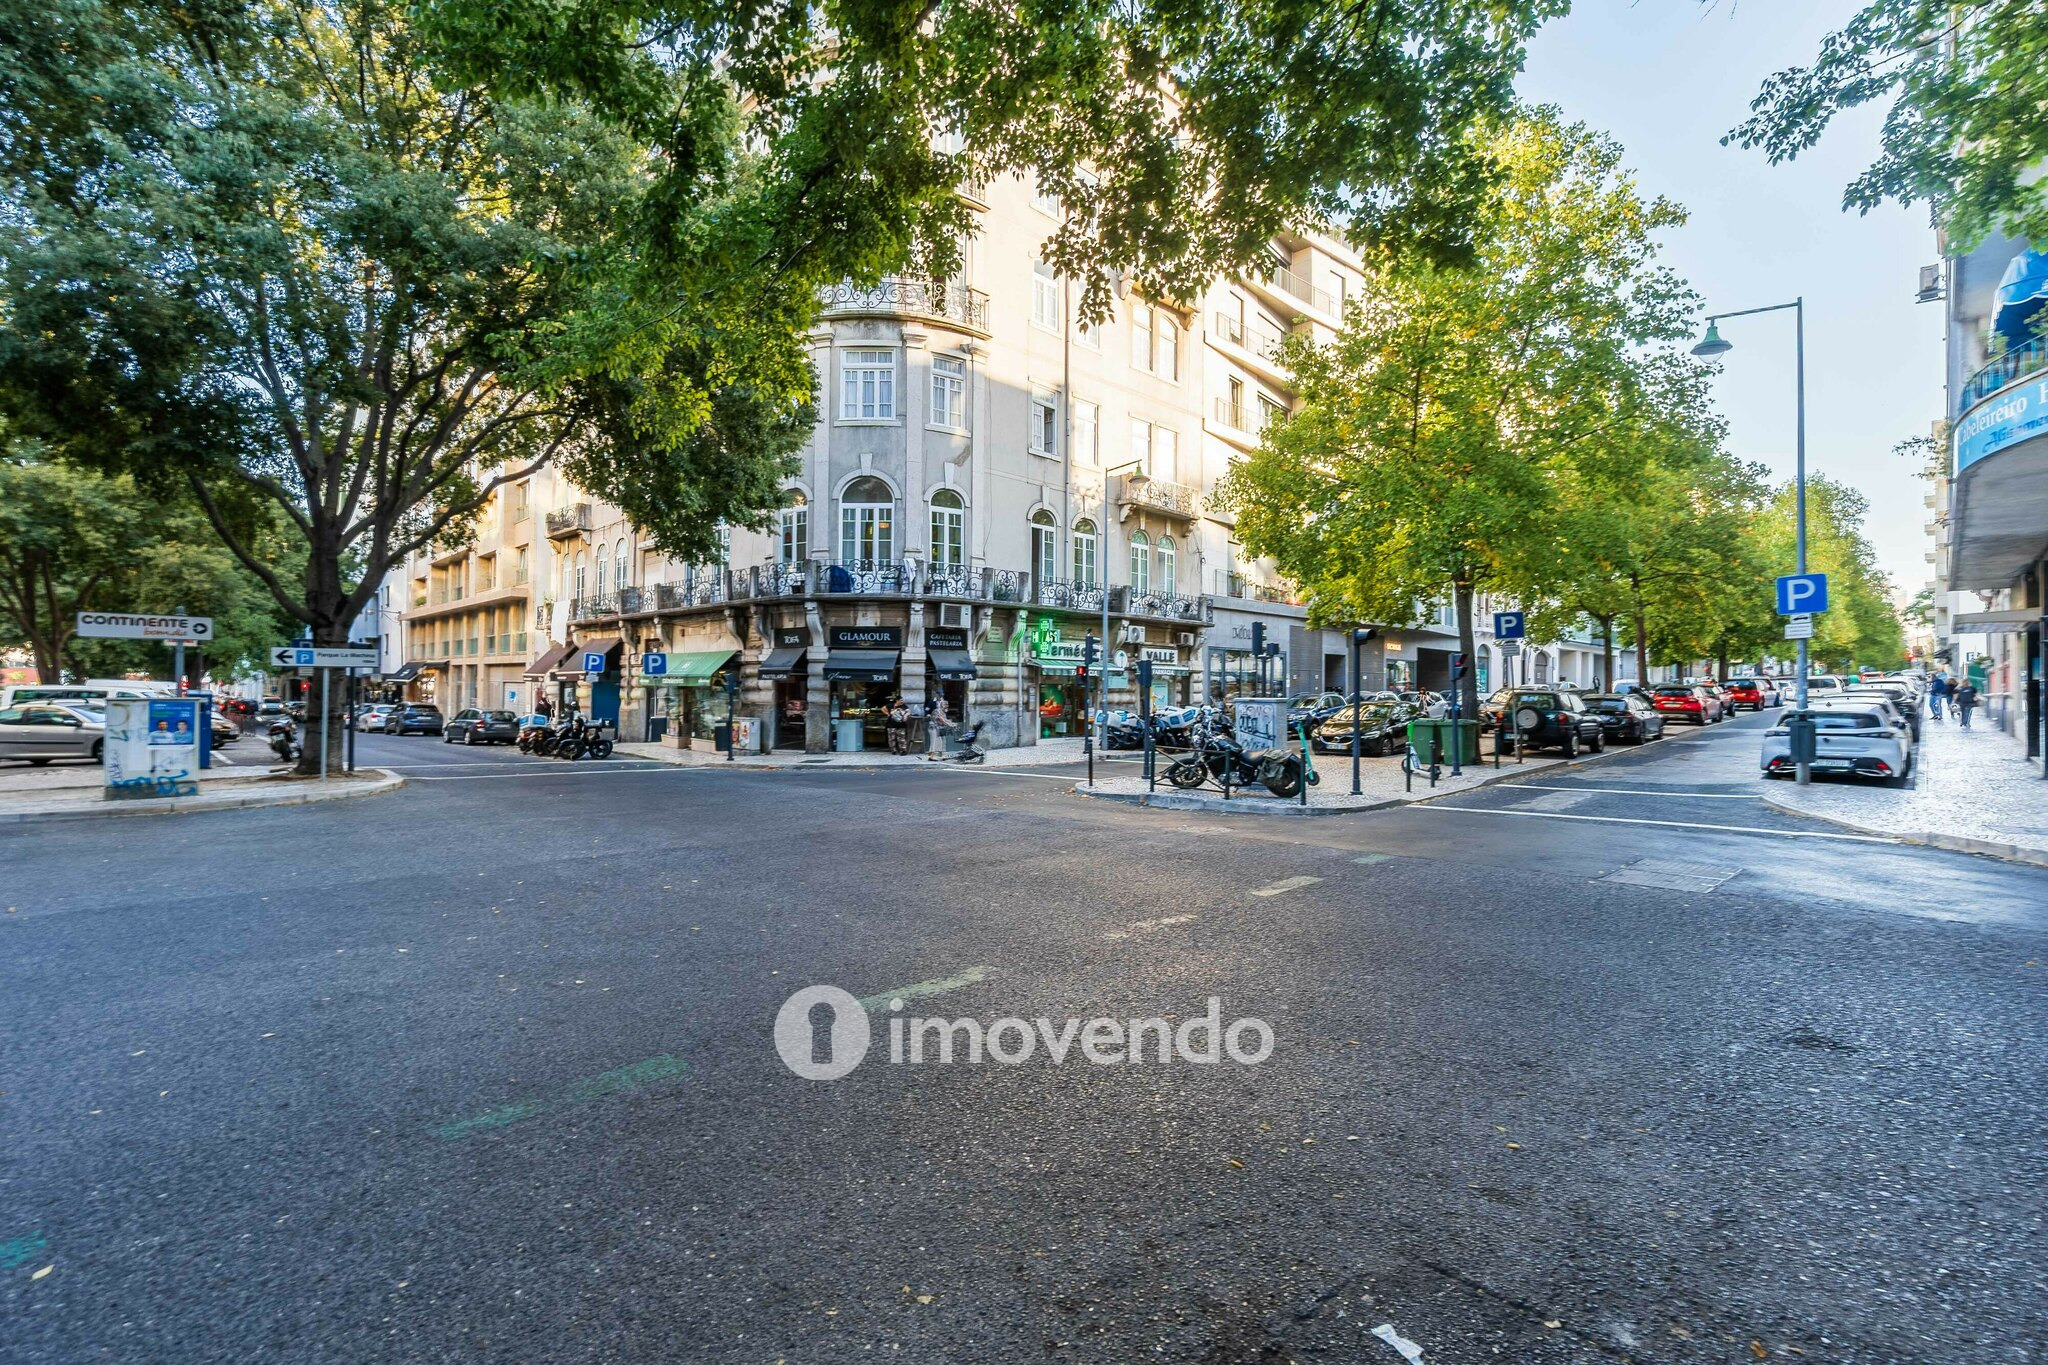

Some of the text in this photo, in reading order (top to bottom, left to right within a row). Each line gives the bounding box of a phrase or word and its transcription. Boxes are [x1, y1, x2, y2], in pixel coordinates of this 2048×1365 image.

[1960, 397, 2028, 446] Cabeleireiro
[1787, 579, 1815, 610] P
[81, 614, 188, 628] CONTINENTE
[1501, 616, 1517, 636] P
[839, 632, 891, 641] GLAMOUR
[588, 656, 600, 670] P
[649, 655, 662, 673] P
